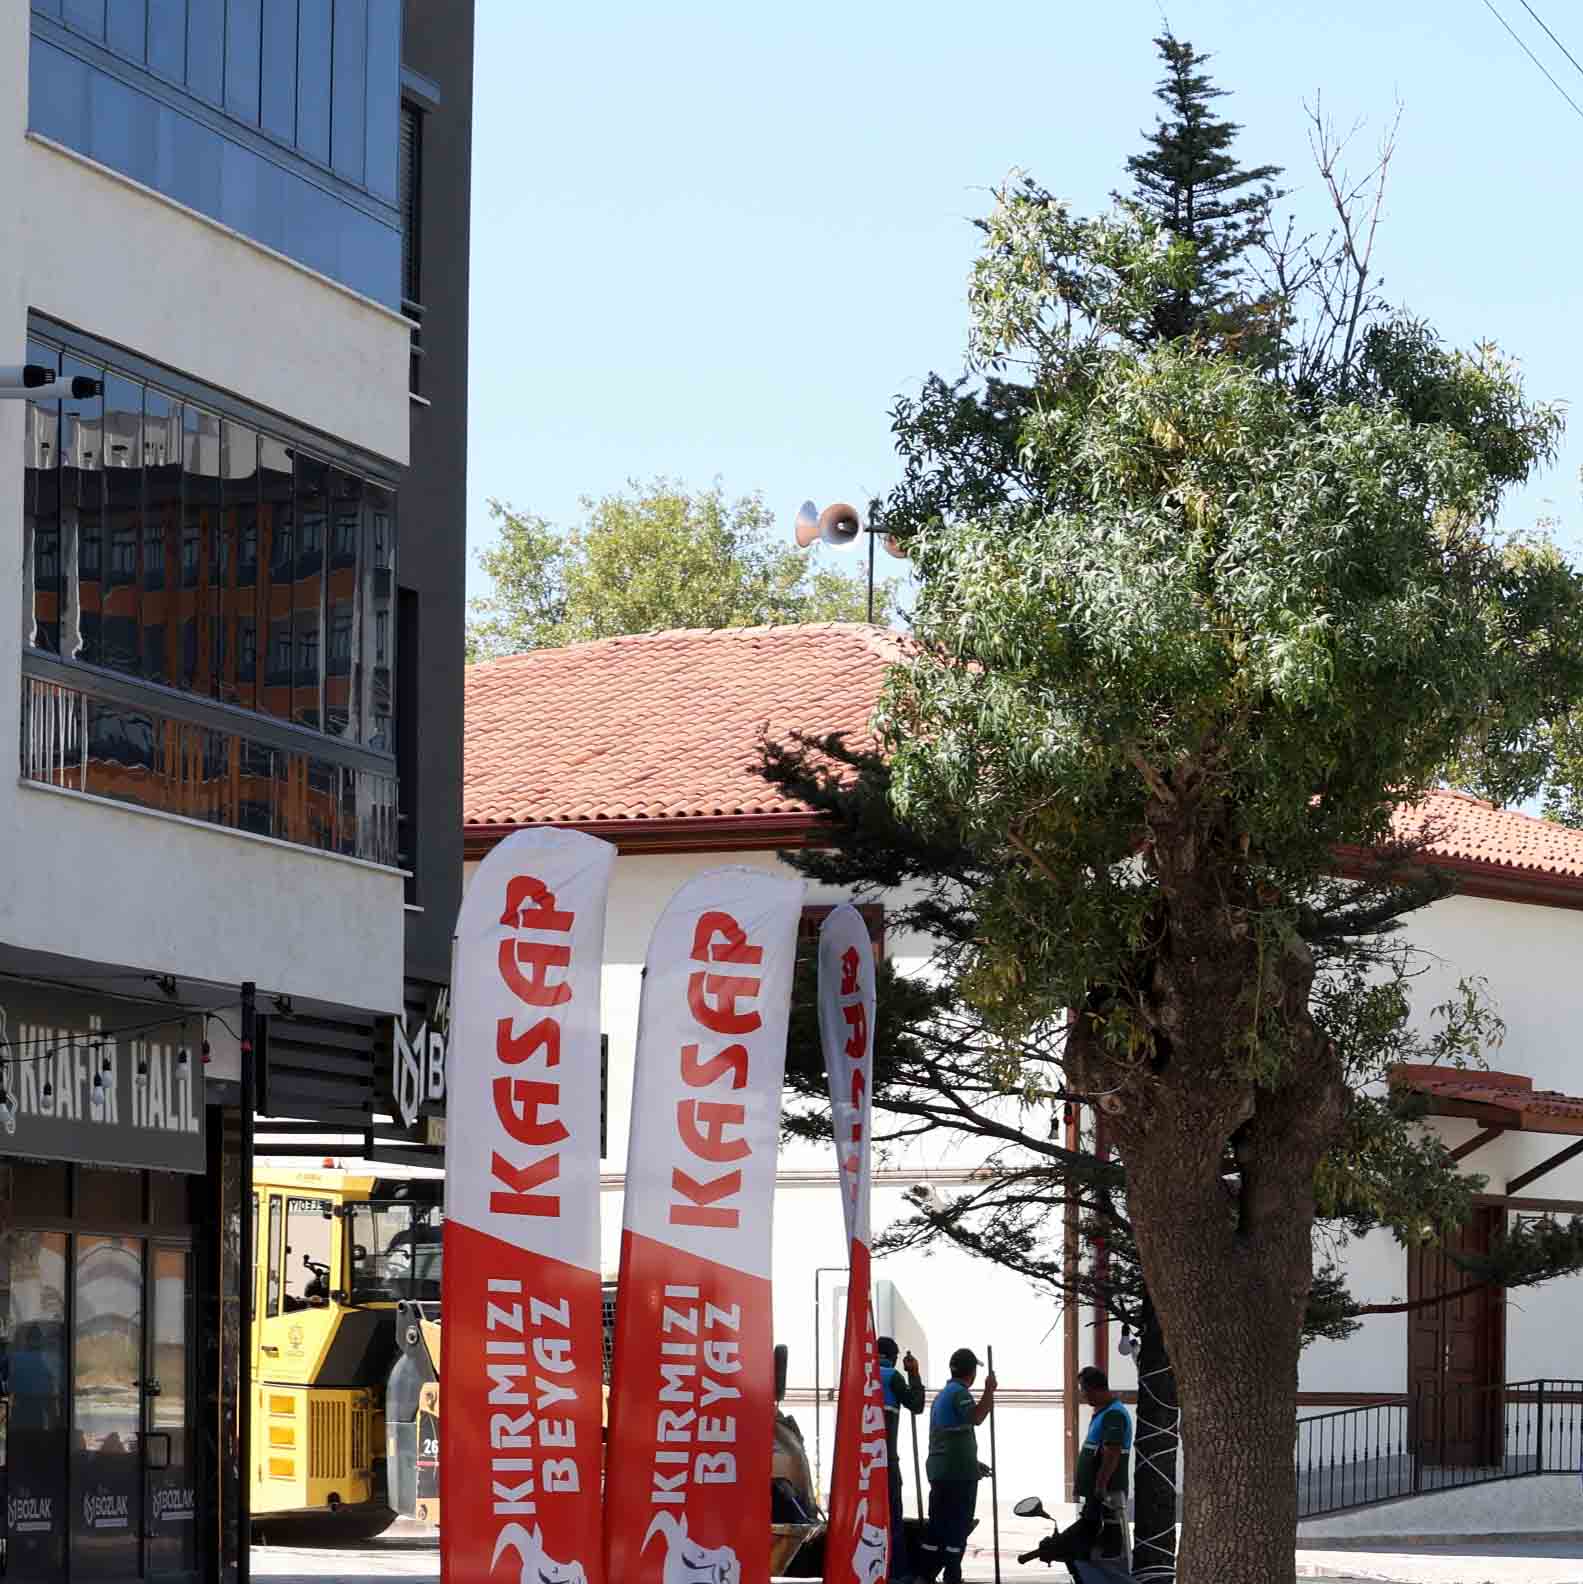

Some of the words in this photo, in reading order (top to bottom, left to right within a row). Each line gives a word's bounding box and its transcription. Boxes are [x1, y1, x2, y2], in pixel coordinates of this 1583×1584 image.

[489, 875, 575, 1218] KASAP
[669, 911, 763, 1229] KASAP
[486, 1278, 536, 1515] KIRMIZI
[530, 1296, 580, 1493] BEYAZ
[651, 1284, 699, 1503] KIRMIZI
[693, 1302, 743, 1484] BEYAZ
